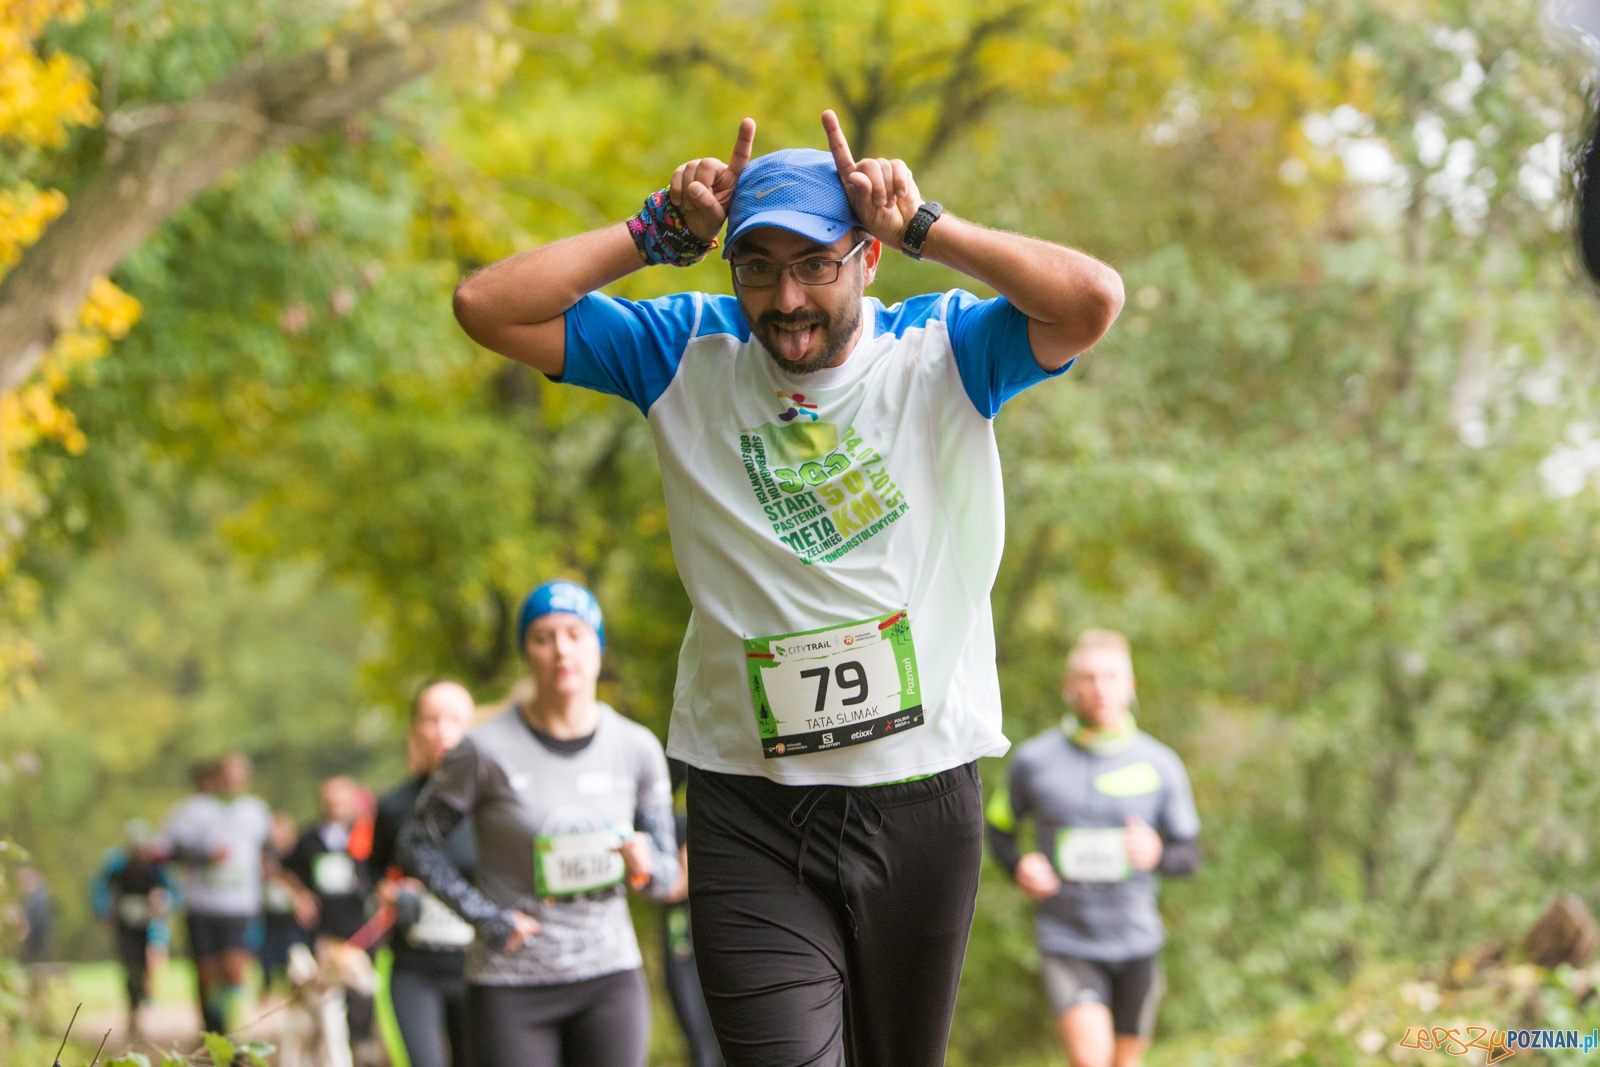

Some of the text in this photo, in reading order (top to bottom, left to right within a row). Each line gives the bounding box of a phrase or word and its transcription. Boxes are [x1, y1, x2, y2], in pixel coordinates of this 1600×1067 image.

[763, 490, 818, 522] START
[817, 469, 866, 507] 50
[772, 504, 827, 534] PASTERKA
[831, 490, 884, 539] KM
[779, 516, 836, 552] META
[800, 660, 869, 713] 79
[905, 657, 915, 696] Poznań
[805, 715, 834, 730] TATA
